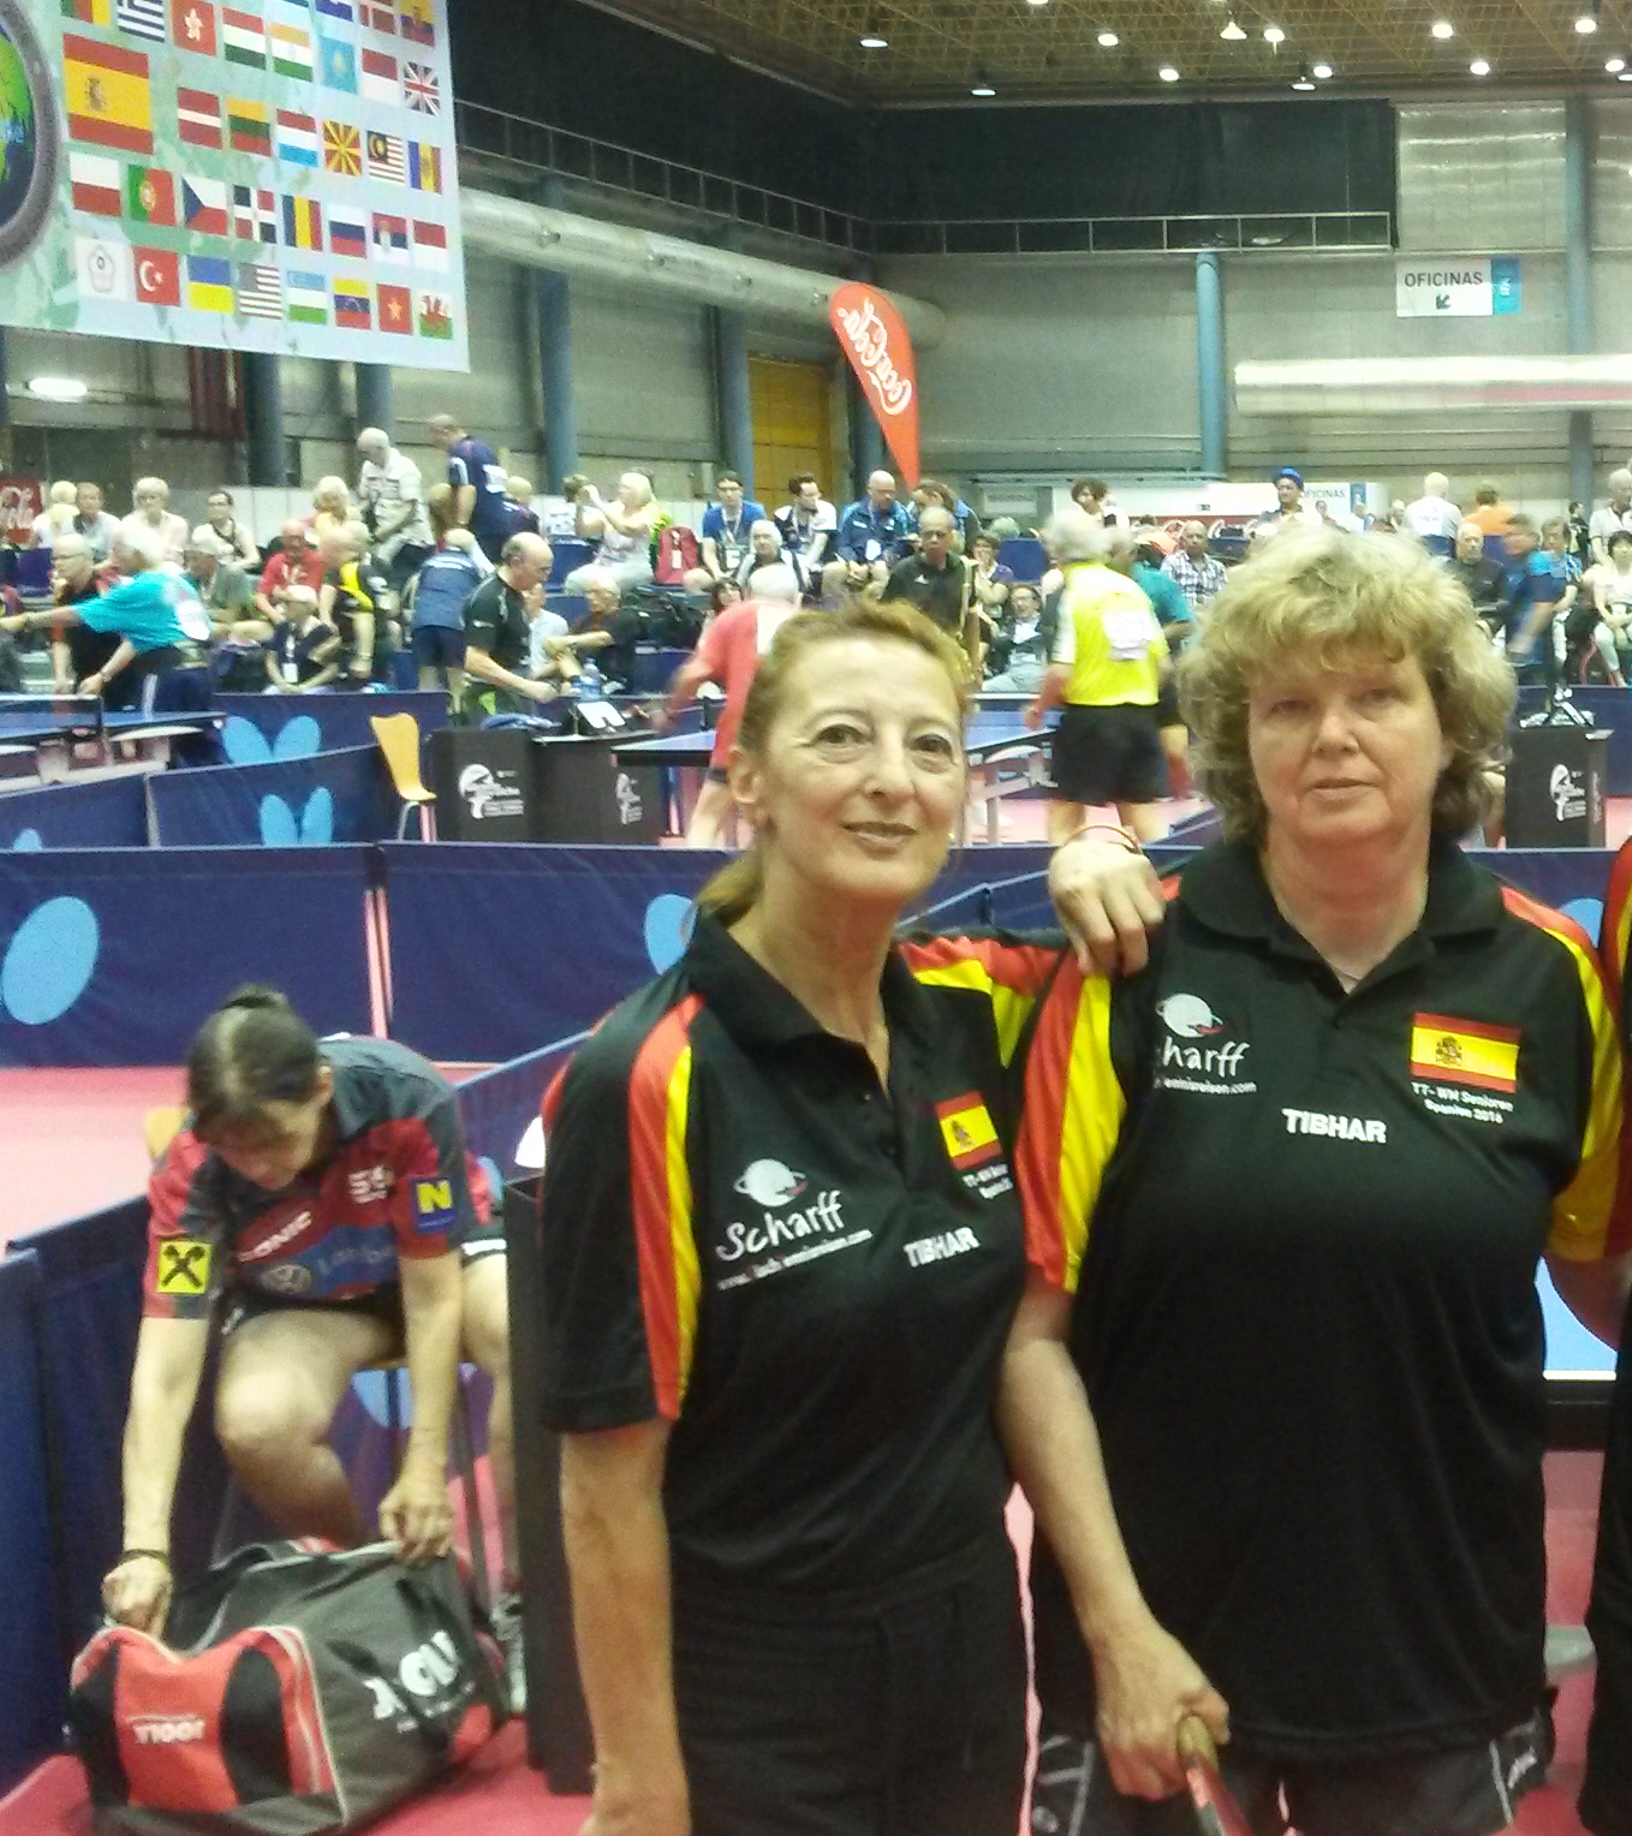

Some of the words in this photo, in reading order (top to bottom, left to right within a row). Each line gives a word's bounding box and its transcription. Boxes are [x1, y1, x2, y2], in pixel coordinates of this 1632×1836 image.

[1404, 271, 1484, 288] OFICINAS
[1162, 1035, 1250, 1078] harff
[1281, 1108, 1388, 1144] TIBHAR
[416, 1180, 453, 1214] N
[716, 1189, 844, 1262] Scharff
[902, 1226, 981, 1268] TIBHAR
